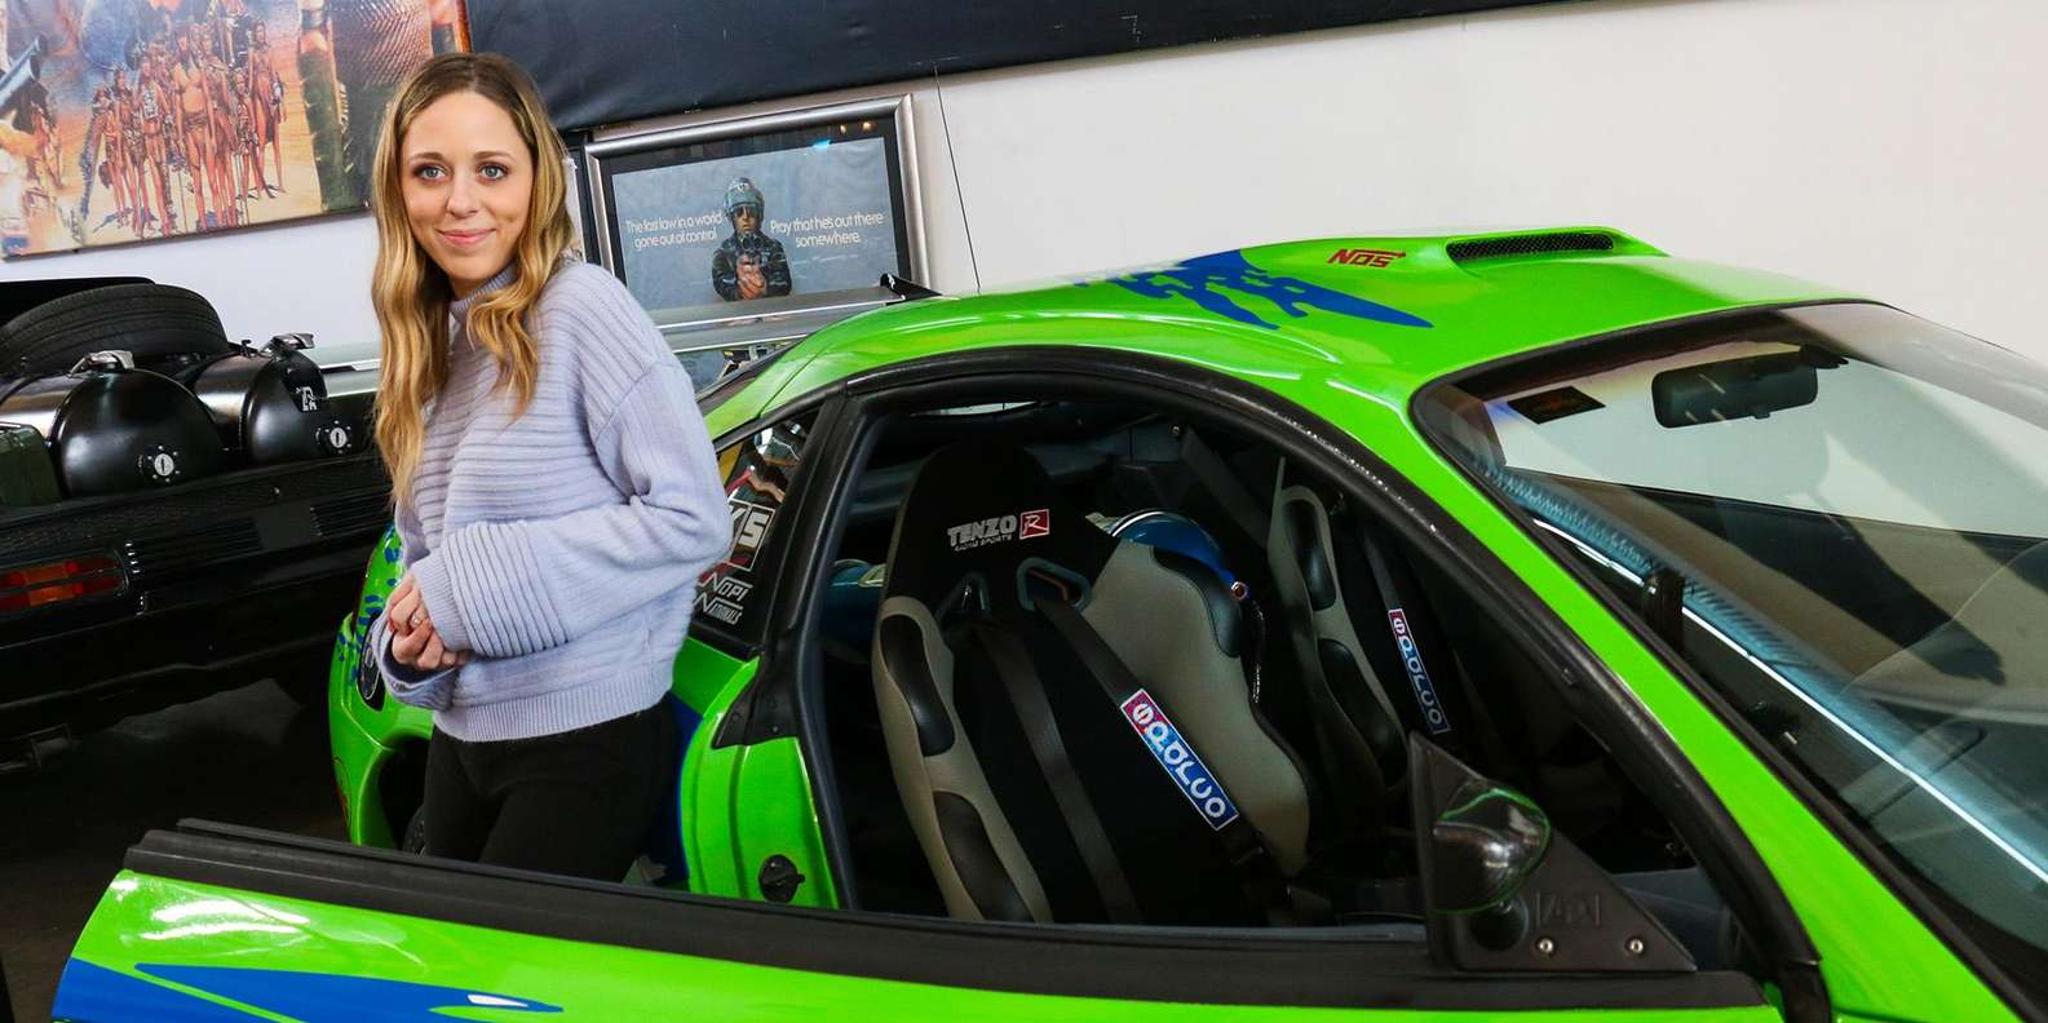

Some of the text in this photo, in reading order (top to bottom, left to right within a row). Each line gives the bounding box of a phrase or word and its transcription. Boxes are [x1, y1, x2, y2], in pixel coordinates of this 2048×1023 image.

[625, 219, 642, 234] The
[643, 218, 658, 232] last
[658, 215, 677, 230] law
[686, 216, 694, 228] a
[694, 209, 722, 226] world
[770, 219, 792, 237] Pray
[792, 216, 814, 232] that
[834, 214, 853, 228] out
[853, 210, 884, 226] there
[634, 226, 717, 252] gone out of control
[1327, 248, 1406, 269] NOS
[947, 514, 1018, 548] TENZO
[697, 571, 754, 602] NOPI
